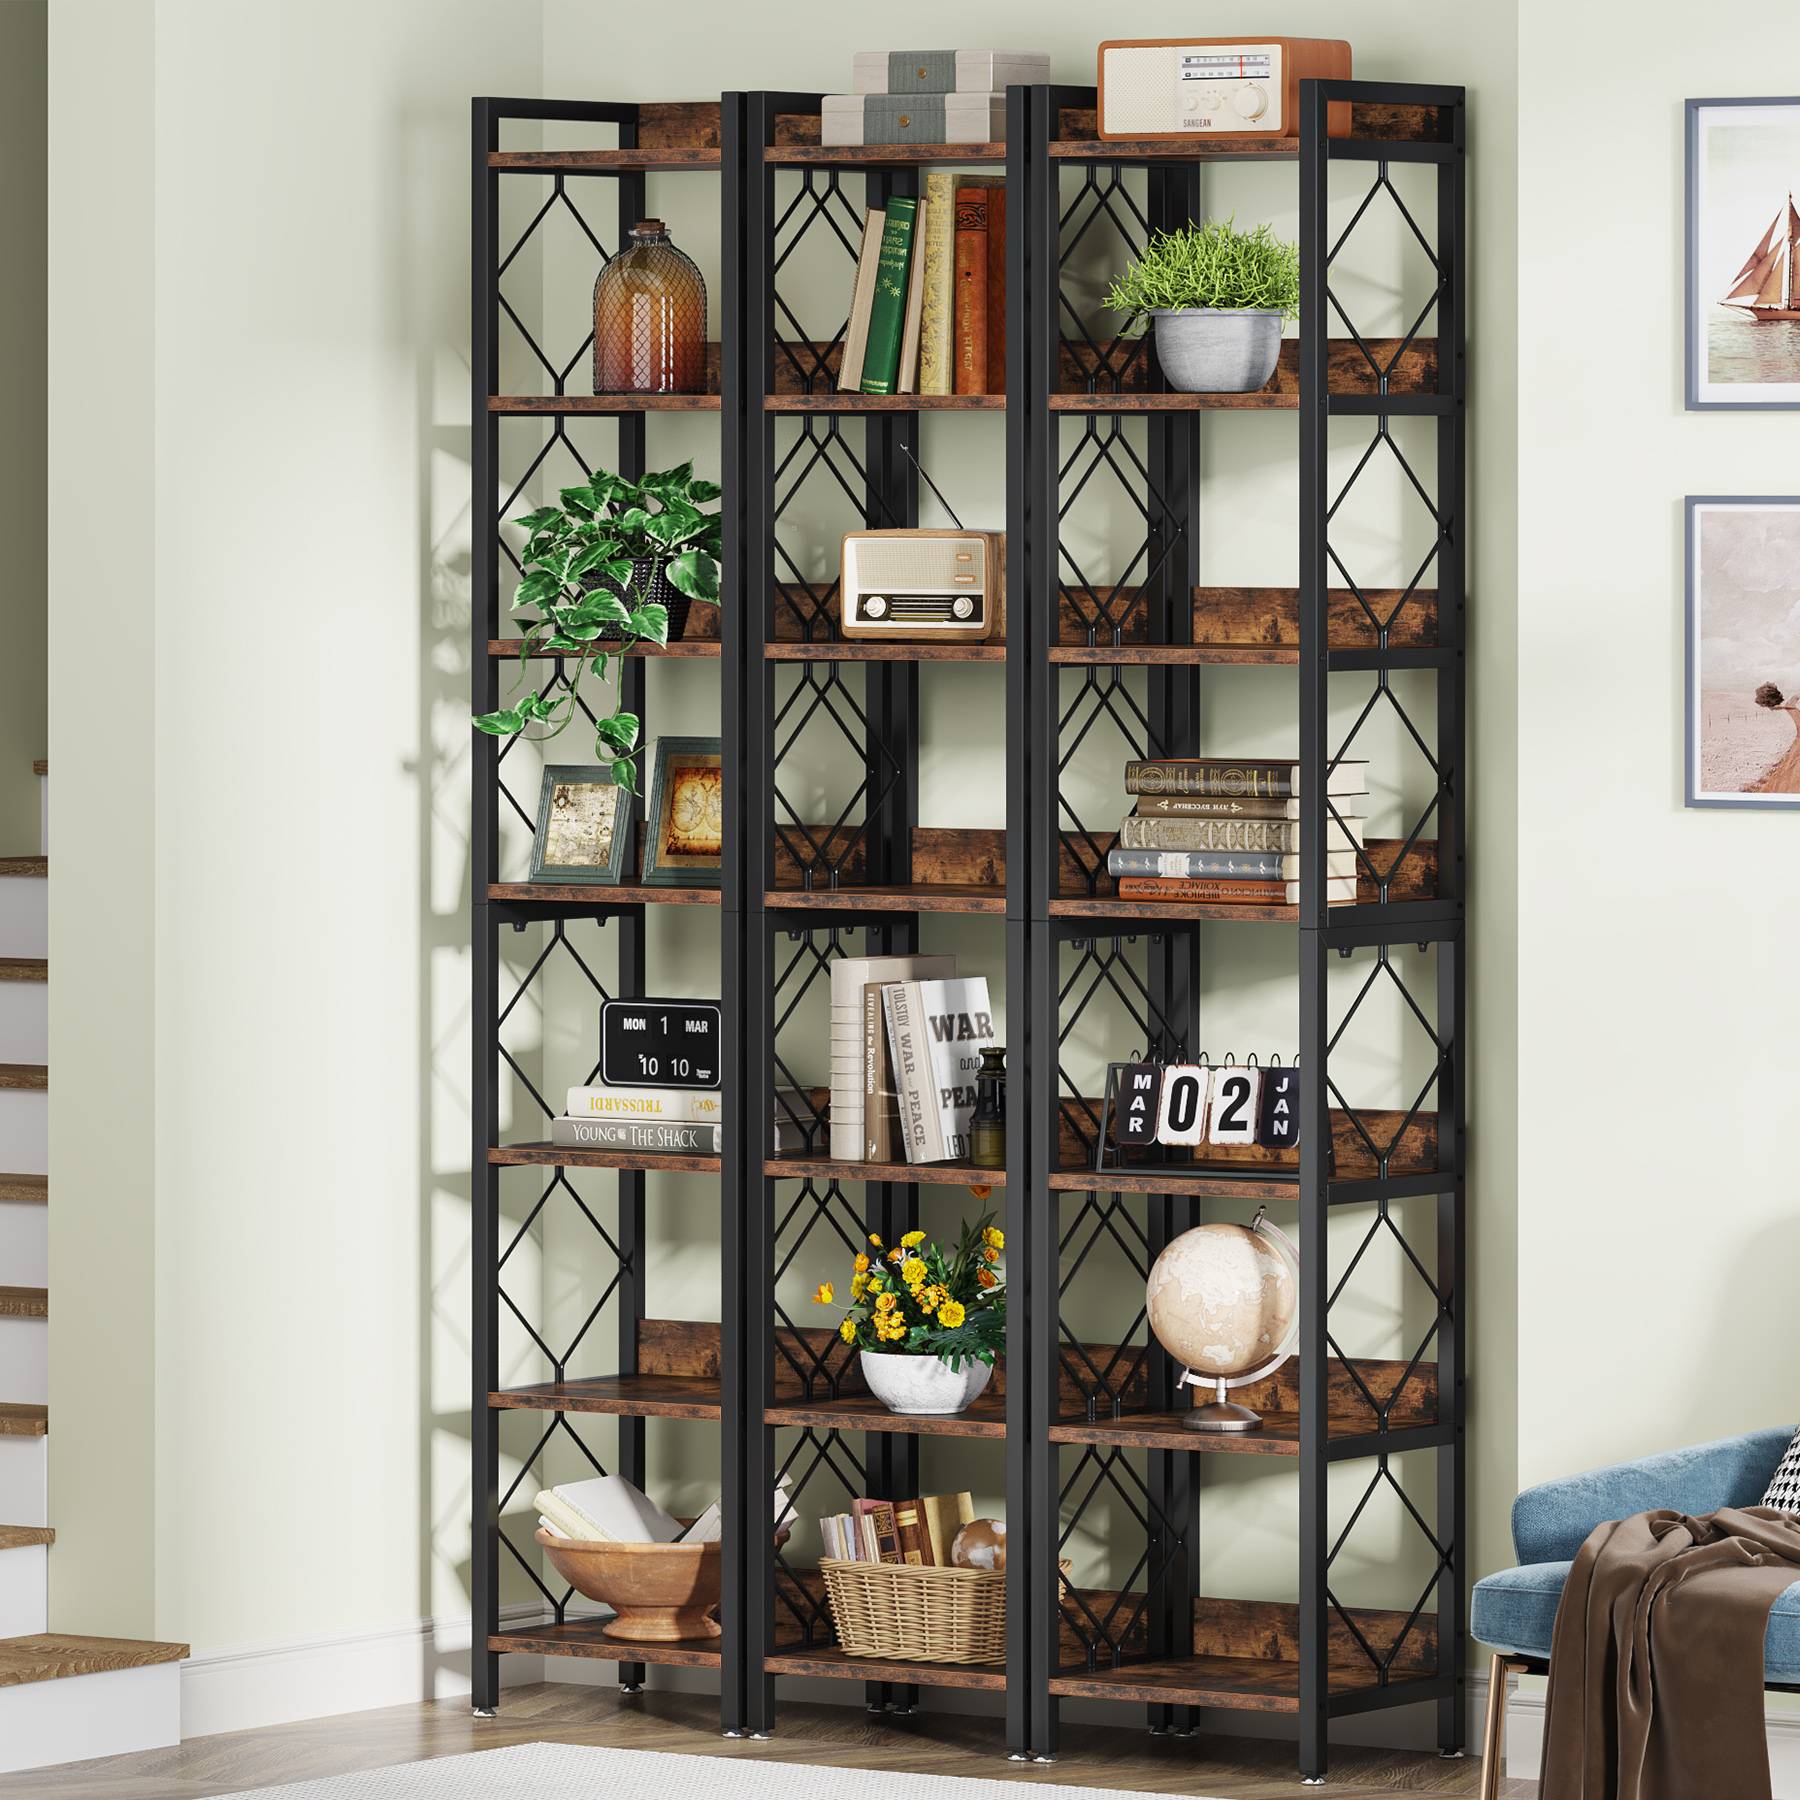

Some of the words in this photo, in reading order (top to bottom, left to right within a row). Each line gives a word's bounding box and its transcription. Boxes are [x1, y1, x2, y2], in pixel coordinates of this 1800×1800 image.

[1183, 118, 1211, 128] SANGEAN
[1172, 803, 1210, 811] БУССЕНАР
[1213, 803, 1229, 811] ЛУИ
[867, 993, 875, 1034] REVEALING
[893, 987, 910, 1027] TOLSTOY
[623, 1017, 646, 1031] MON
[660, 1016, 668, 1035] 1
[685, 1020, 708, 1033] MAR
[928, 1012, 994, 1043] WAR
[900, 1032, 915, 1074] WAR
[639, 1057, 659, 1076] 10
[670, 1058, 690, 1077] 10
[867, 1047, 875, 1095] Revolution
[590, 1096, 662, 1113] TRUSSARDI
[940, 1085, 978, 1109] PEA
[908, 1089, 926, 1146] PEACE
[946, 1133, 966, 1158] LEO
